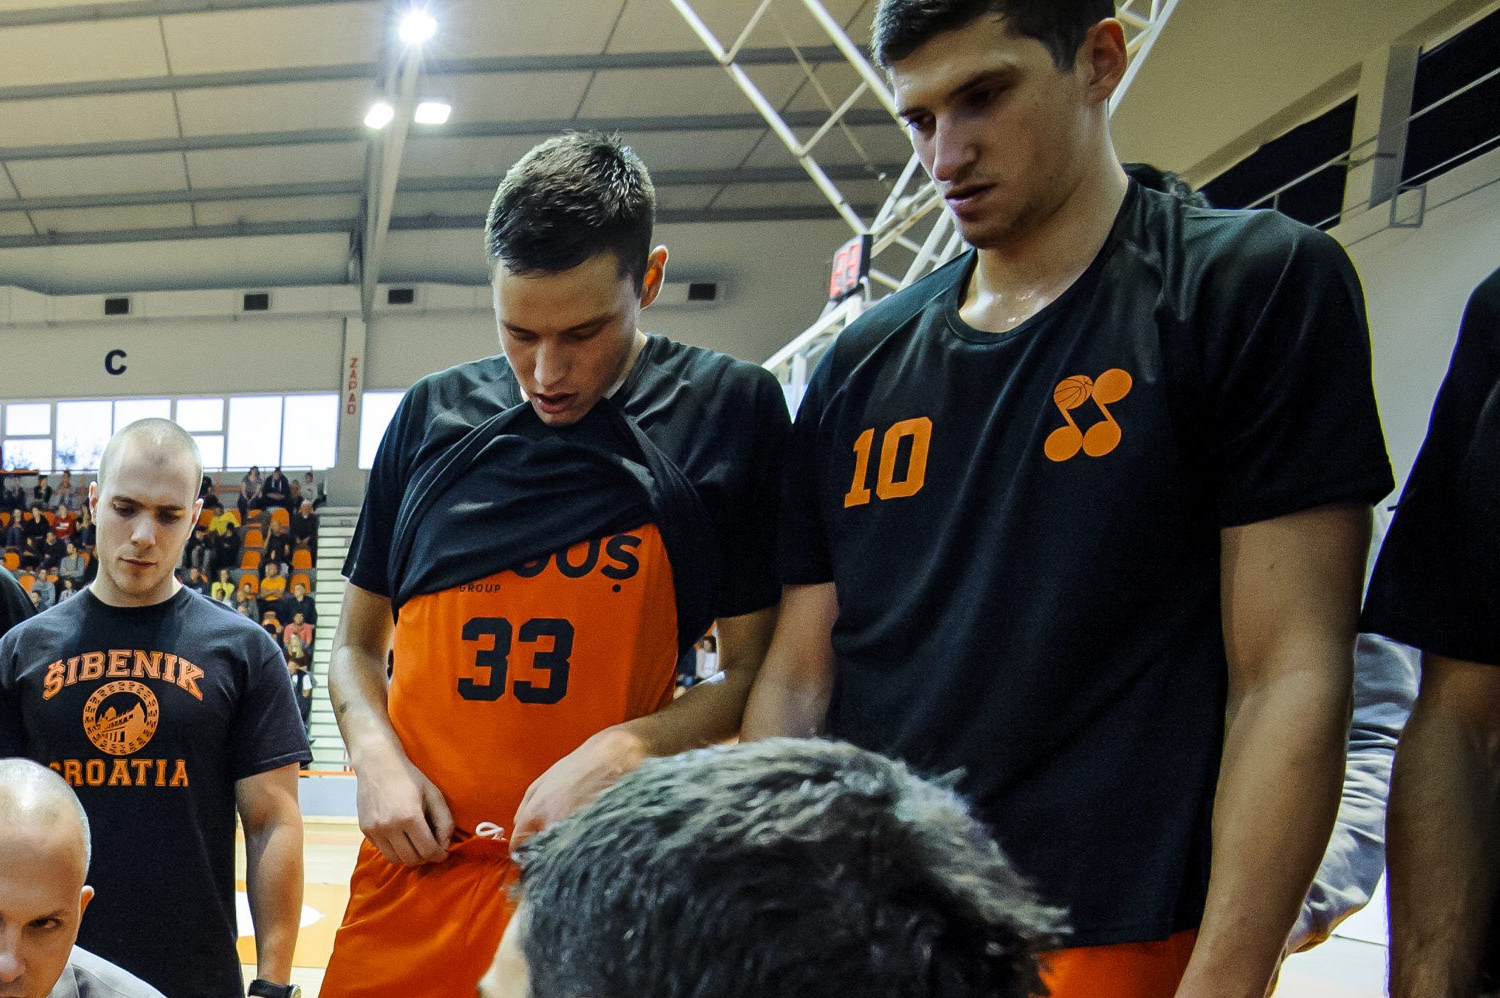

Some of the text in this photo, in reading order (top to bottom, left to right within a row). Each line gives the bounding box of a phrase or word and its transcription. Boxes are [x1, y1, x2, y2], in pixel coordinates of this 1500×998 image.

[104, 349, 127, 376] C
[347, 357, 358, 415] ZAPAD
[844, 416, 933, 508] 10
[459, 583, 501, 593] GROUP
[42, 649, 205, 701] ŠIBENIK
[457, 616, 575, 704] 33
